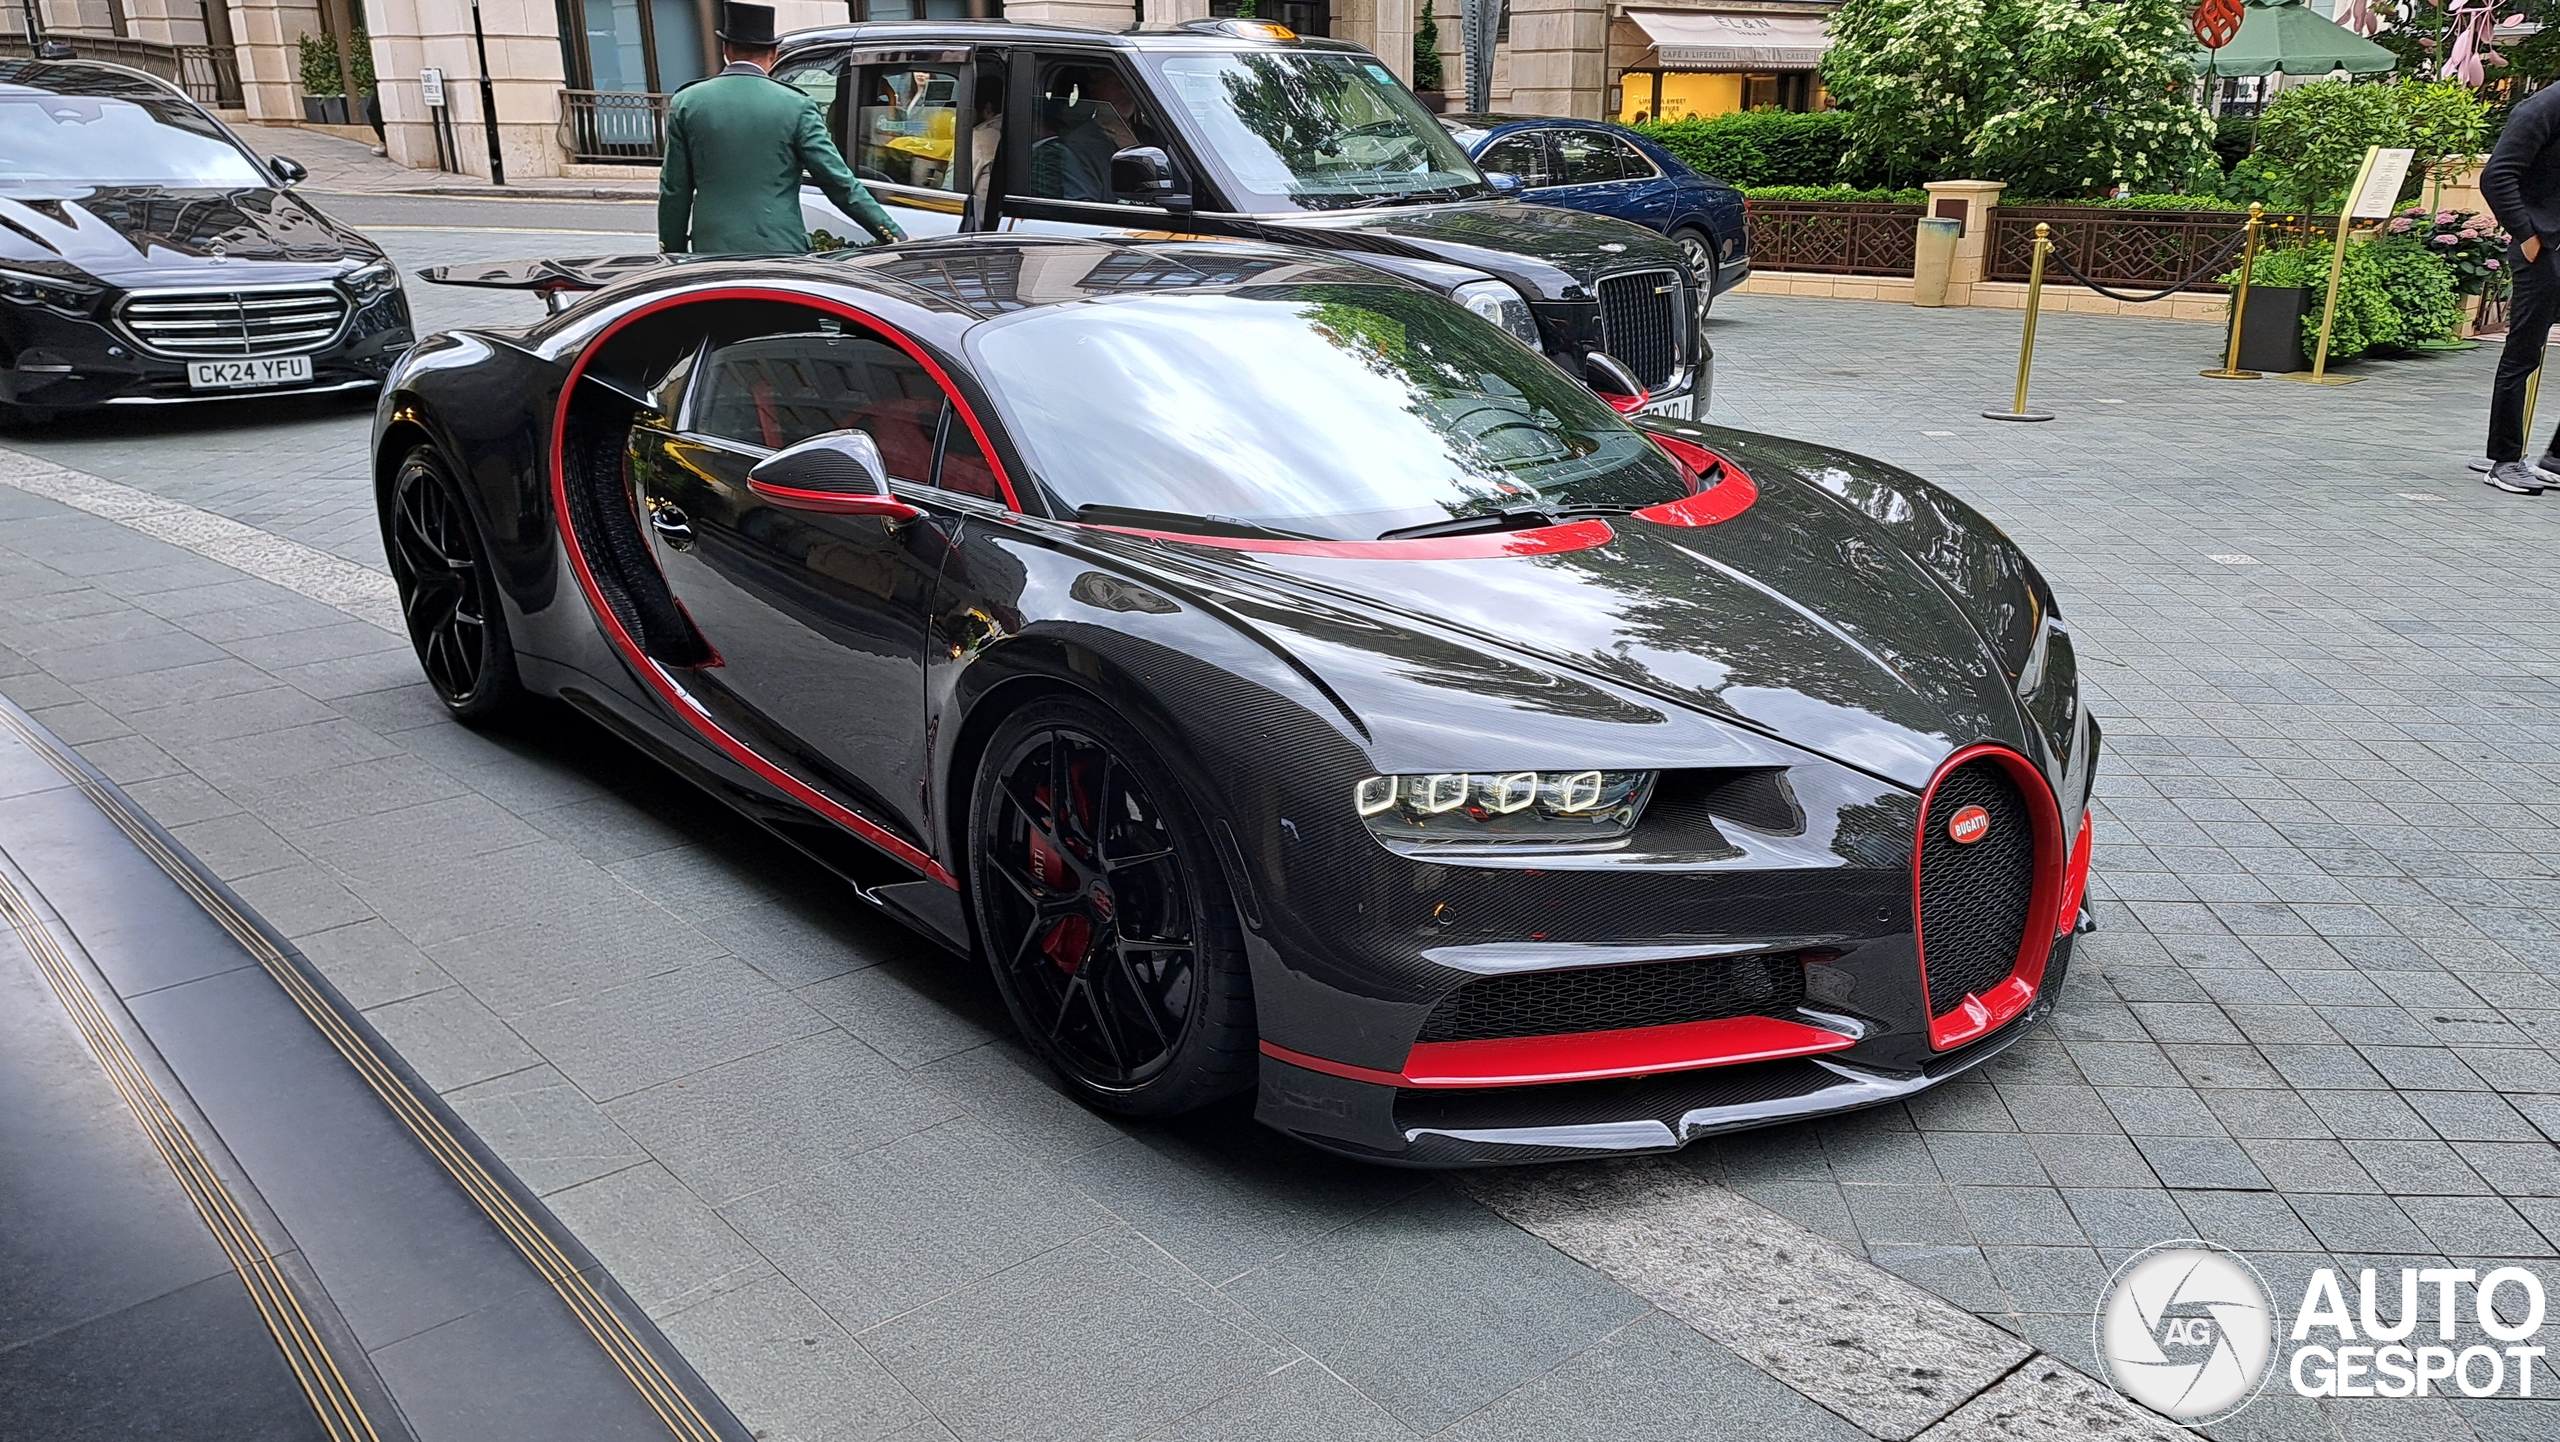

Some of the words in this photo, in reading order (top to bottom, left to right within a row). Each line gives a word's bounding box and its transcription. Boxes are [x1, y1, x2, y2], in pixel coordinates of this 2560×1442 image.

[1714, 17, 1771, 29] EL&N
[1662, 50, 1682, 58] CAFÉ
[1692, 51, 1731, 59] LIFESTYLE
[199, 363, 256, 383] CK24
[262, 359, 303, 379] YFU
[1955, 815, 1987, 837] BUGATTI
